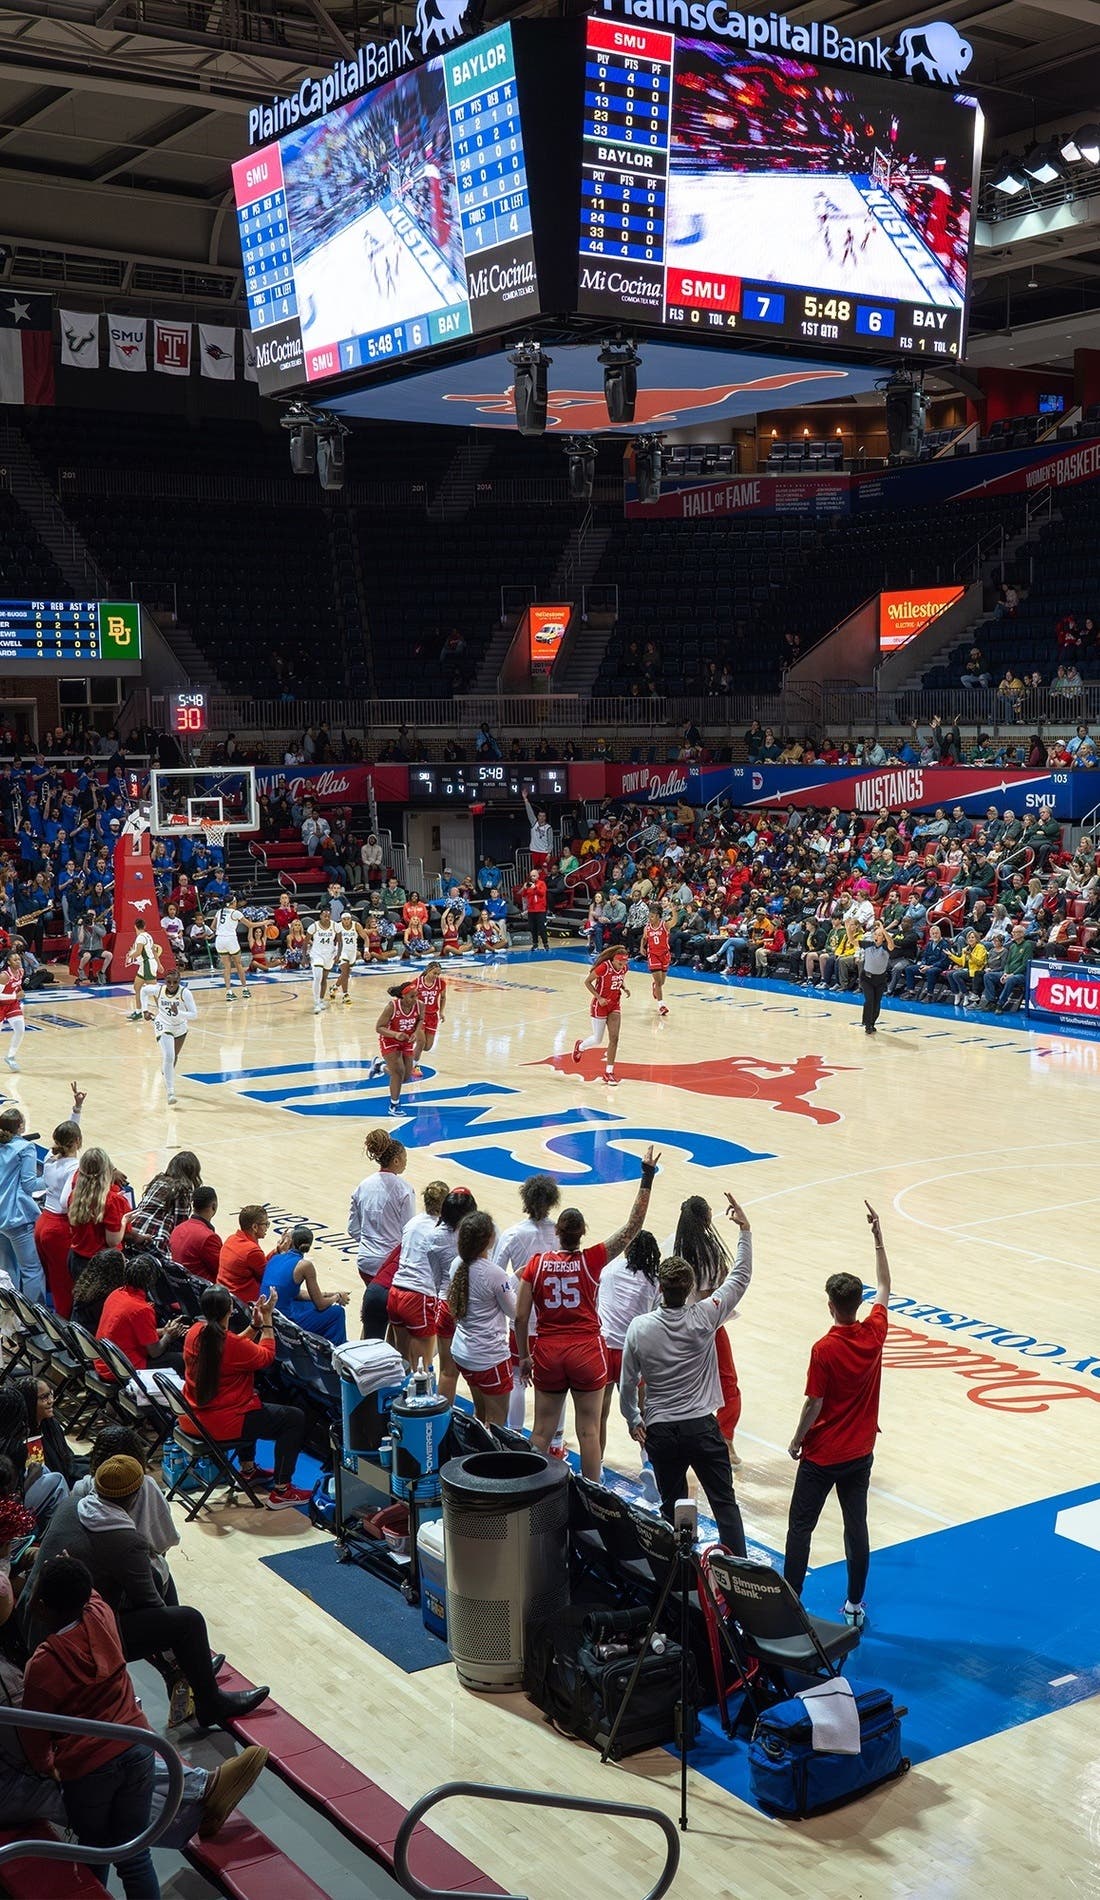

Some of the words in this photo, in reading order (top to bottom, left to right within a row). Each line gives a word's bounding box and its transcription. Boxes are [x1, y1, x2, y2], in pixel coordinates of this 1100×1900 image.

[603, 0, 893, 72] lainsCapitalBank
[614, 32, 646, 49] SMU
[453, 43, 506, 86] BAYLOR
[598, 53, 609, 64] PLY
[625, 59, 638, 70] PTS
[652, 64, 661, 74] PF
[600, 68, 606, 77] 0
[627, 73, 634, 83] 4
[653, 78, 659, 88] 0
[599, 82, 605, 92] 1
[627, 87, 634, 97] 0
[652, 92, 658, 102] 0
[595, 96, 608, 107] 13
[626, 102, 633, 111] 0
[651, 106, 658, 116] 0
[594, 110, 608, 121] 23
[626, 116, 632, 126] 0
[651, 120, 657, 130] 0
[594, 124, 608, 135] 33
[625, 130, 632, 140] 3
[650, 135, 657, 144] 0
[598, 148, 653, 167] BAYLOR
[246, 163, 268, 188] SMU
[593, 171, 605, 181] PLY
[620, 175, 634, 186] PTS
[647, 179, 657, 190] PF
[595, 185, 602, 194] 5
[623, 189, 630, 199] 2
[648, 193, 655, 203] 0
[591, 199, 604, 209] 11
[622, 203, 629, 213] 0
[648, 207, 654, 217] 1
[476, 227, 483, 244] 1
[510, 214, 518, 232] 4
[590, 213, 604, 224] 24
[622, 217, 629, 227] 0
[647, 221, 654, 231] 0
[590, 227, 604, 238] 33
[622, 231, 628, 241] 0
[646, 235, 653, 245] 0
[589, 241, 603, 252] 44
[621, 246, 628, 255] 4
[646, 249, 652, 259] 0
[681, 279, 726, 300] SMU
[258, 309, 264, 323] 0
[282, 299, 288, 314] 4
[758, 297, 770, 318] 7
[804, 296, 850, 321] 5:48
[670, 309, 684, 320] FLS
[691, 311, 699, 322] 0
[709, 313, 723, 326] TOL
[727, 315, 736, 327] 4
[869, 312, 882, 332] 6
[913, 310, 948, 329] BAY
[111, 330, 144, 342] SMU
[801, 322, 818, 336] 1ST
[820, 324, 838, 338] QTR
[312, 352, 333, 372] SMU
[347, 345, 353, 364] 7
[368, 334, 393, 357] 5:48
[398, 340, 402, 352] 1
[413, 325, 421, 345] 6
[439, 312, 460, 334] BAY
[900, 338, 912, 349] FLS
[919, 339, 925, 350] 1
[934, 341, 946, 352] TOL
[949, 343, 957, 354] 4
[683, 495, 714, 517] HALL
[715, 492, 724, 507] OF
[726, 481, 760, 509] FAME
[32, 602, 45, 610] PTS
[51, 603, 64, 611] REB
[70, 603, 82, 611] AST
[107, 617, 131, 646] BU
[178, 694, 204, 706] 5:48
[177, 708, 201, 730] 30
[479, 768, 503, 779] 5:48
[622, 773, 638, 794] PONY
[640, 768, 649, 789] UP
[689, 767, 699, 776] 102
[734, 769, 743, 777] 103
[1053, 774, 1067, 784] 103
[426, 782, 432, 792] 7
[447, 785, 452, 793] 0
[554, 782, 561, 792] 6
[649, 777, 687, 800] Dallas
[855, 769, 924, 811] MUSTANGS
[1025, 794, 1056, 807] SMU
[654, 936, 659, 944] 0
[424, 997, 434, 1005] 13
[1050, 983, 1098, 1009] SMU
[542, 1260, 581, 1272] PETERSON
[501, 1282, 510, 1292] 14
[544, 1276, 581, 1309] 35
[732, 1576, 781, 1593] Simmons
